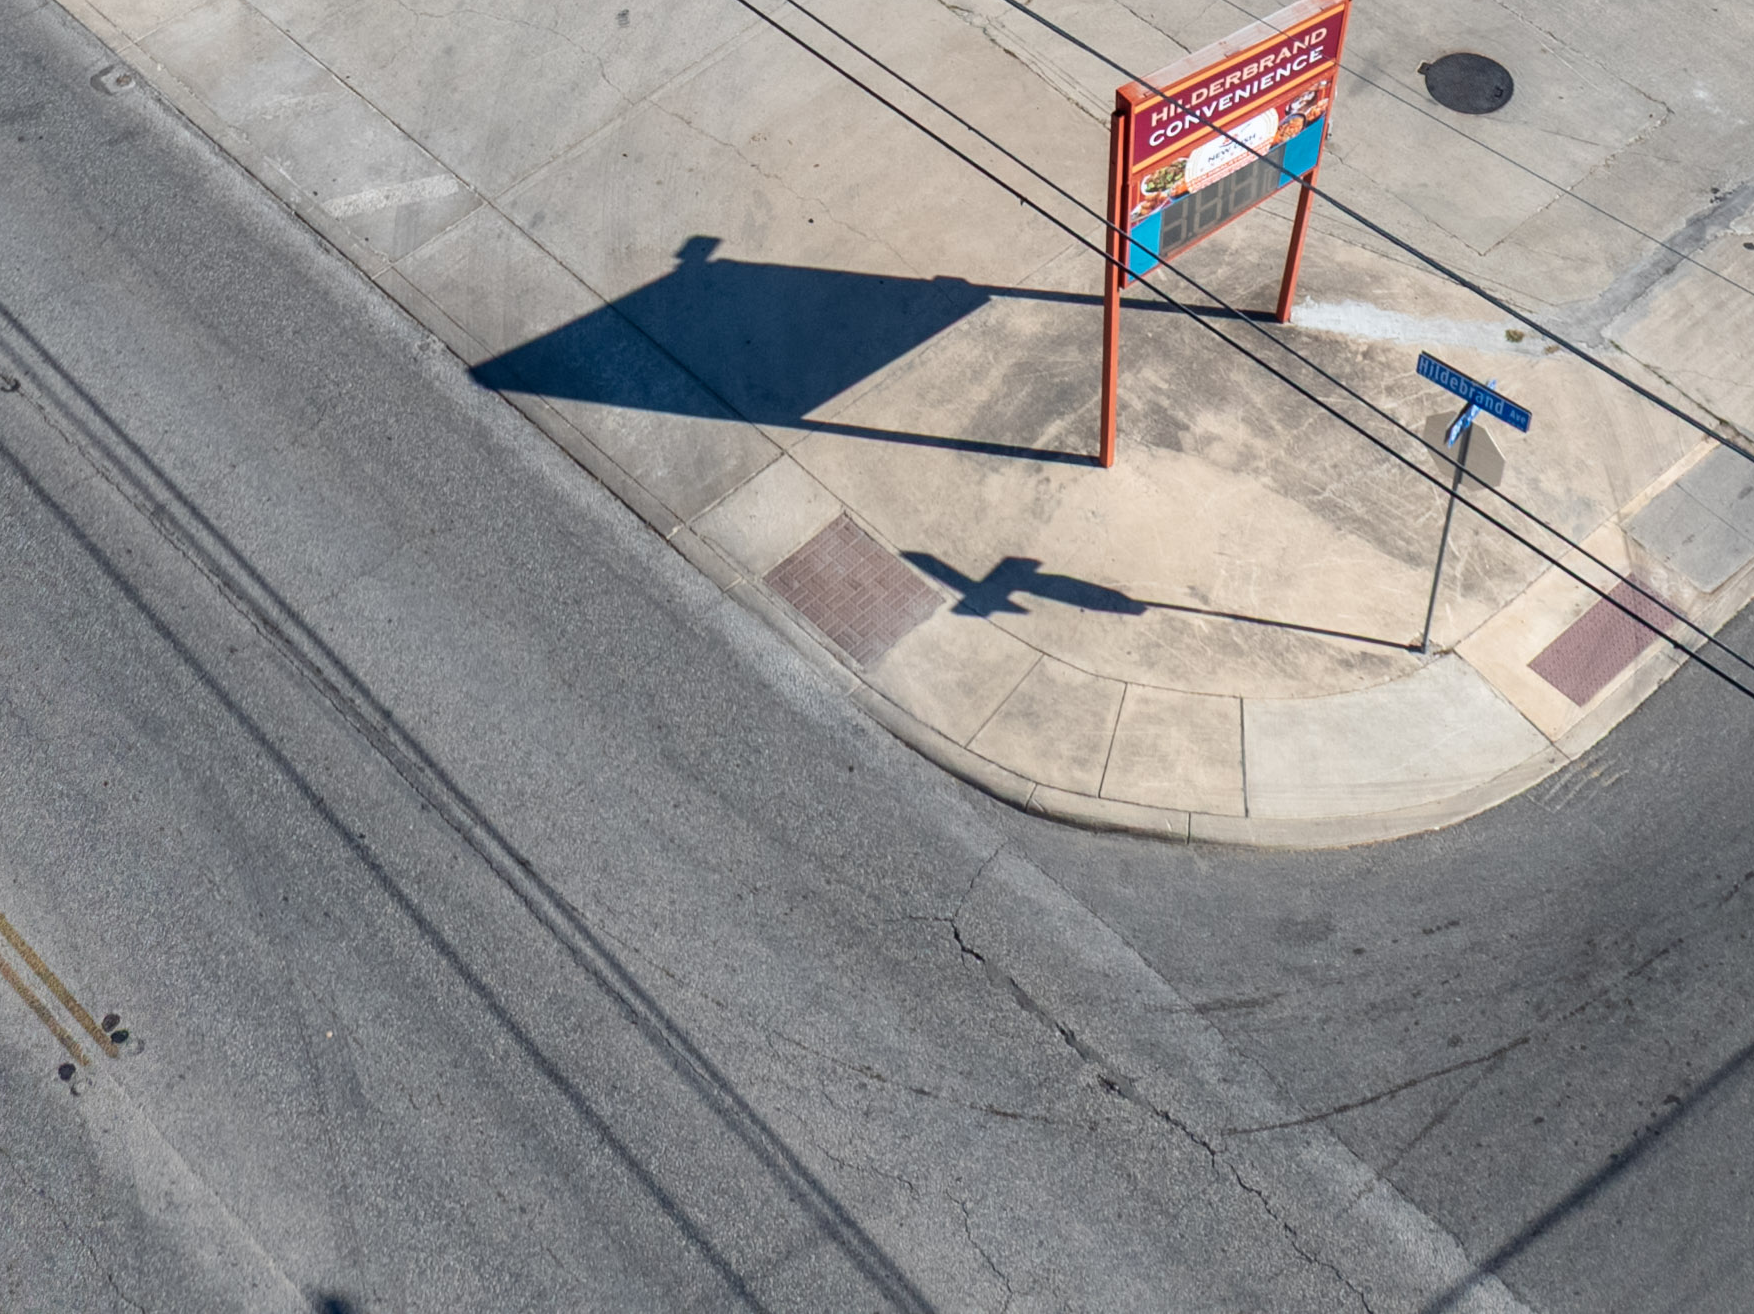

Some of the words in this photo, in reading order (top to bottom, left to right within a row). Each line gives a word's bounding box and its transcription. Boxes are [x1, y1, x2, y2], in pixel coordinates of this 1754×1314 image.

[1148, 46, 1324, 147] CONVENIENCE
[1151, 28, 1328, 128] HILDERBRAND
[1418, 357, 1505, 415] Hildebrand
[1509, 410, 1526, 425] Ave
